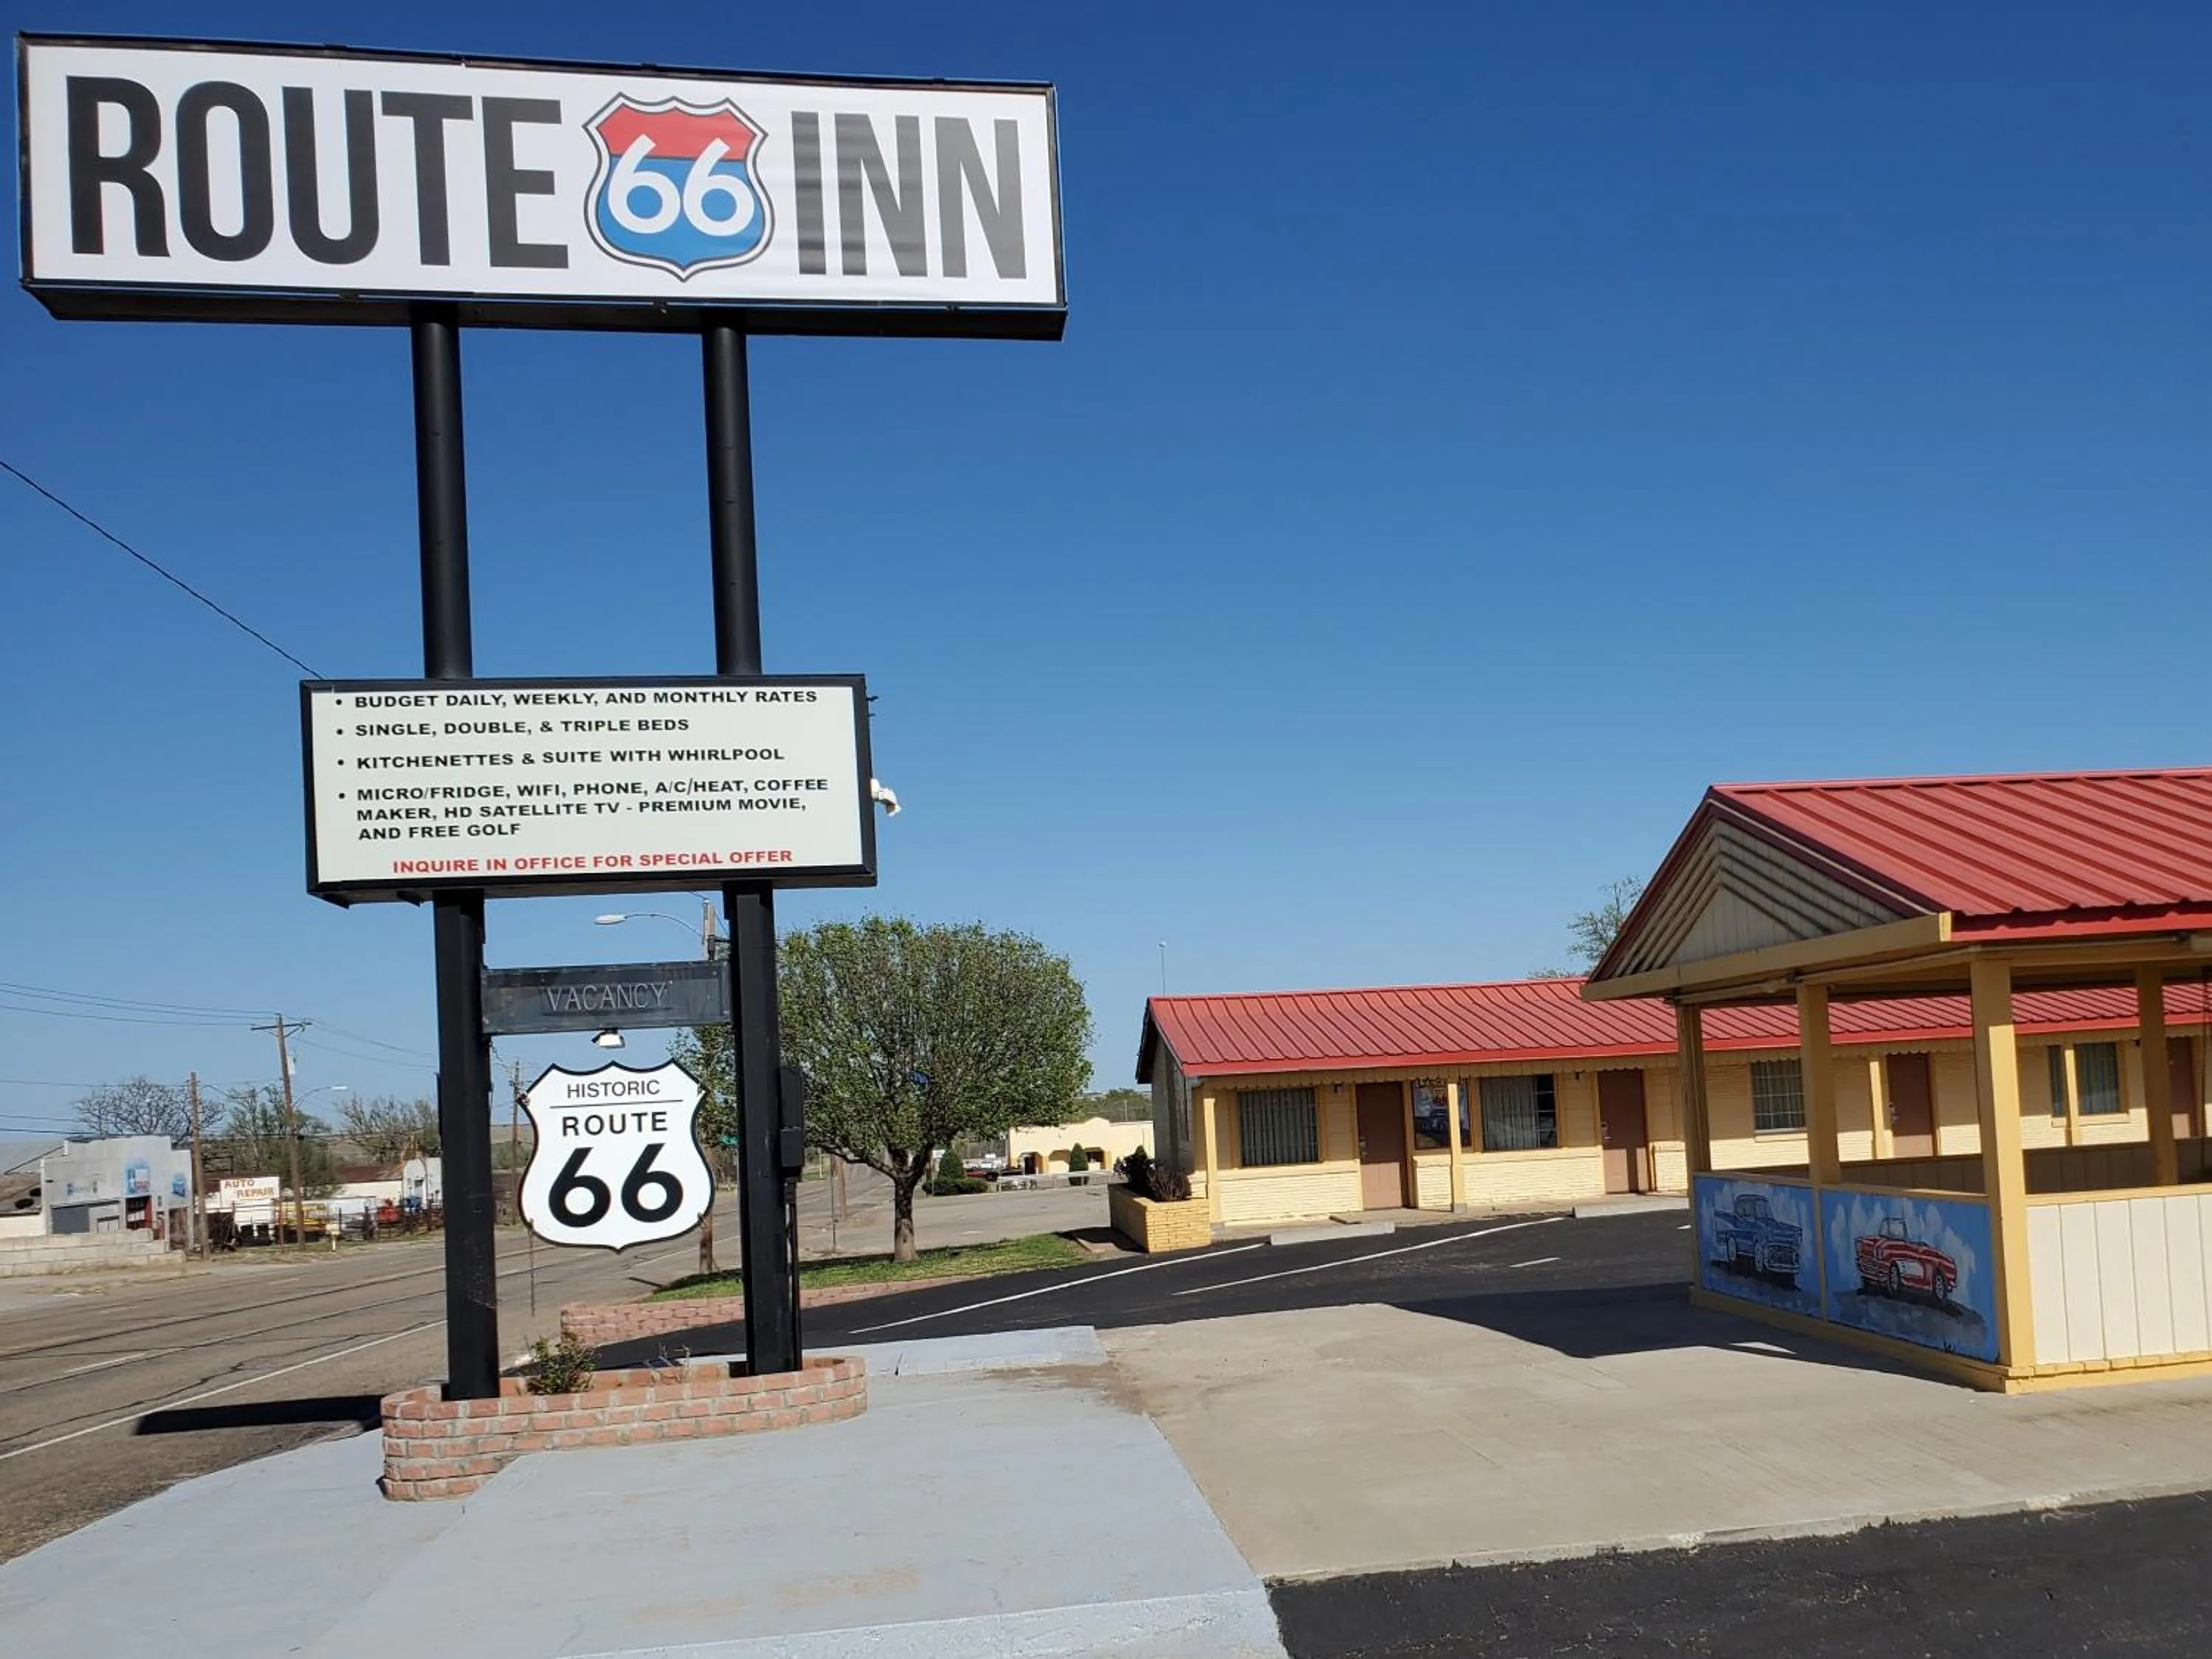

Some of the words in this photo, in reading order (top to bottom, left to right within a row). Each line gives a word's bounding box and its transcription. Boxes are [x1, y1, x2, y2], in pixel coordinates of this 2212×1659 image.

[66, 75, 568, 268] ROUTE
[608, 133, 755, 236] 66
[791, 111, 1026, 279] INN
[355, 695, 438, 708] BUDGET
[446, 694, 507, 708] DAILY,
[514, 692, 598, 706] WEEKLY,
[605, 692, 646, 704] AND
[653, 691, 748, 703] MONTHLY
[756, 690, 817, 703] RATES
[355, 723, 437, 737] SINGLE,
[445, 722, 532, 735] DOUBLE,
[540, 720, 553, 732] &
[560, 720, 630, 732] TRIPLE
[638, 719, 689, 731] BEDS
[357, 754, 514, 769] KITCHENETTES
[522, 753, 535, 765] &
[543, 751, 602, 763] SUITE
[611, 750, 661, 762] WITH
[668, 748, 785, 761] WHIRLPOOL
[358, 785, 511, 801] MICRO/FRIDGE,
[517, 784, 567, 798] WIFI,
[574, 782, 648, 796] PHONE,
[655, 779, 748, 795] A/C/HEAT,
[754, 779, 828, 791] COFFEE
[357, 807, 437, 821] MAKER,
[445, 806, 472, 818] HD
[479, 803, 588, 817] SATELLITE
[594, 802, 619, 813] TV
[639, 799, 731, 813] PREMIUM
[738, 798, 806, 811] MOVIE,
[358, 827, 401, 841] AND
[408, 825, 460, 838] FREE
[467, 823, 521, 836] GOLF
[393, 859, 479, 873] INQUIRE
[486, 858, 507, 871] IN
[514, 856, 586, 870] OFFICE
[593, 855, 633, 868] FOR
[639, 852, 723, 866] SPECIAL
[729, 850, 793, 863] OFFER
[546, 983, 666, 1012] VACANCY
[566, 1079, 660, 1099] HISTORIC
[562, 1111, 667, 1136] ROUTE
[224, 1179, 254, 1189] AUTO
[237, 1187, 274, 1198] REPAIR
[549, 1143, 683, 1228] 66
